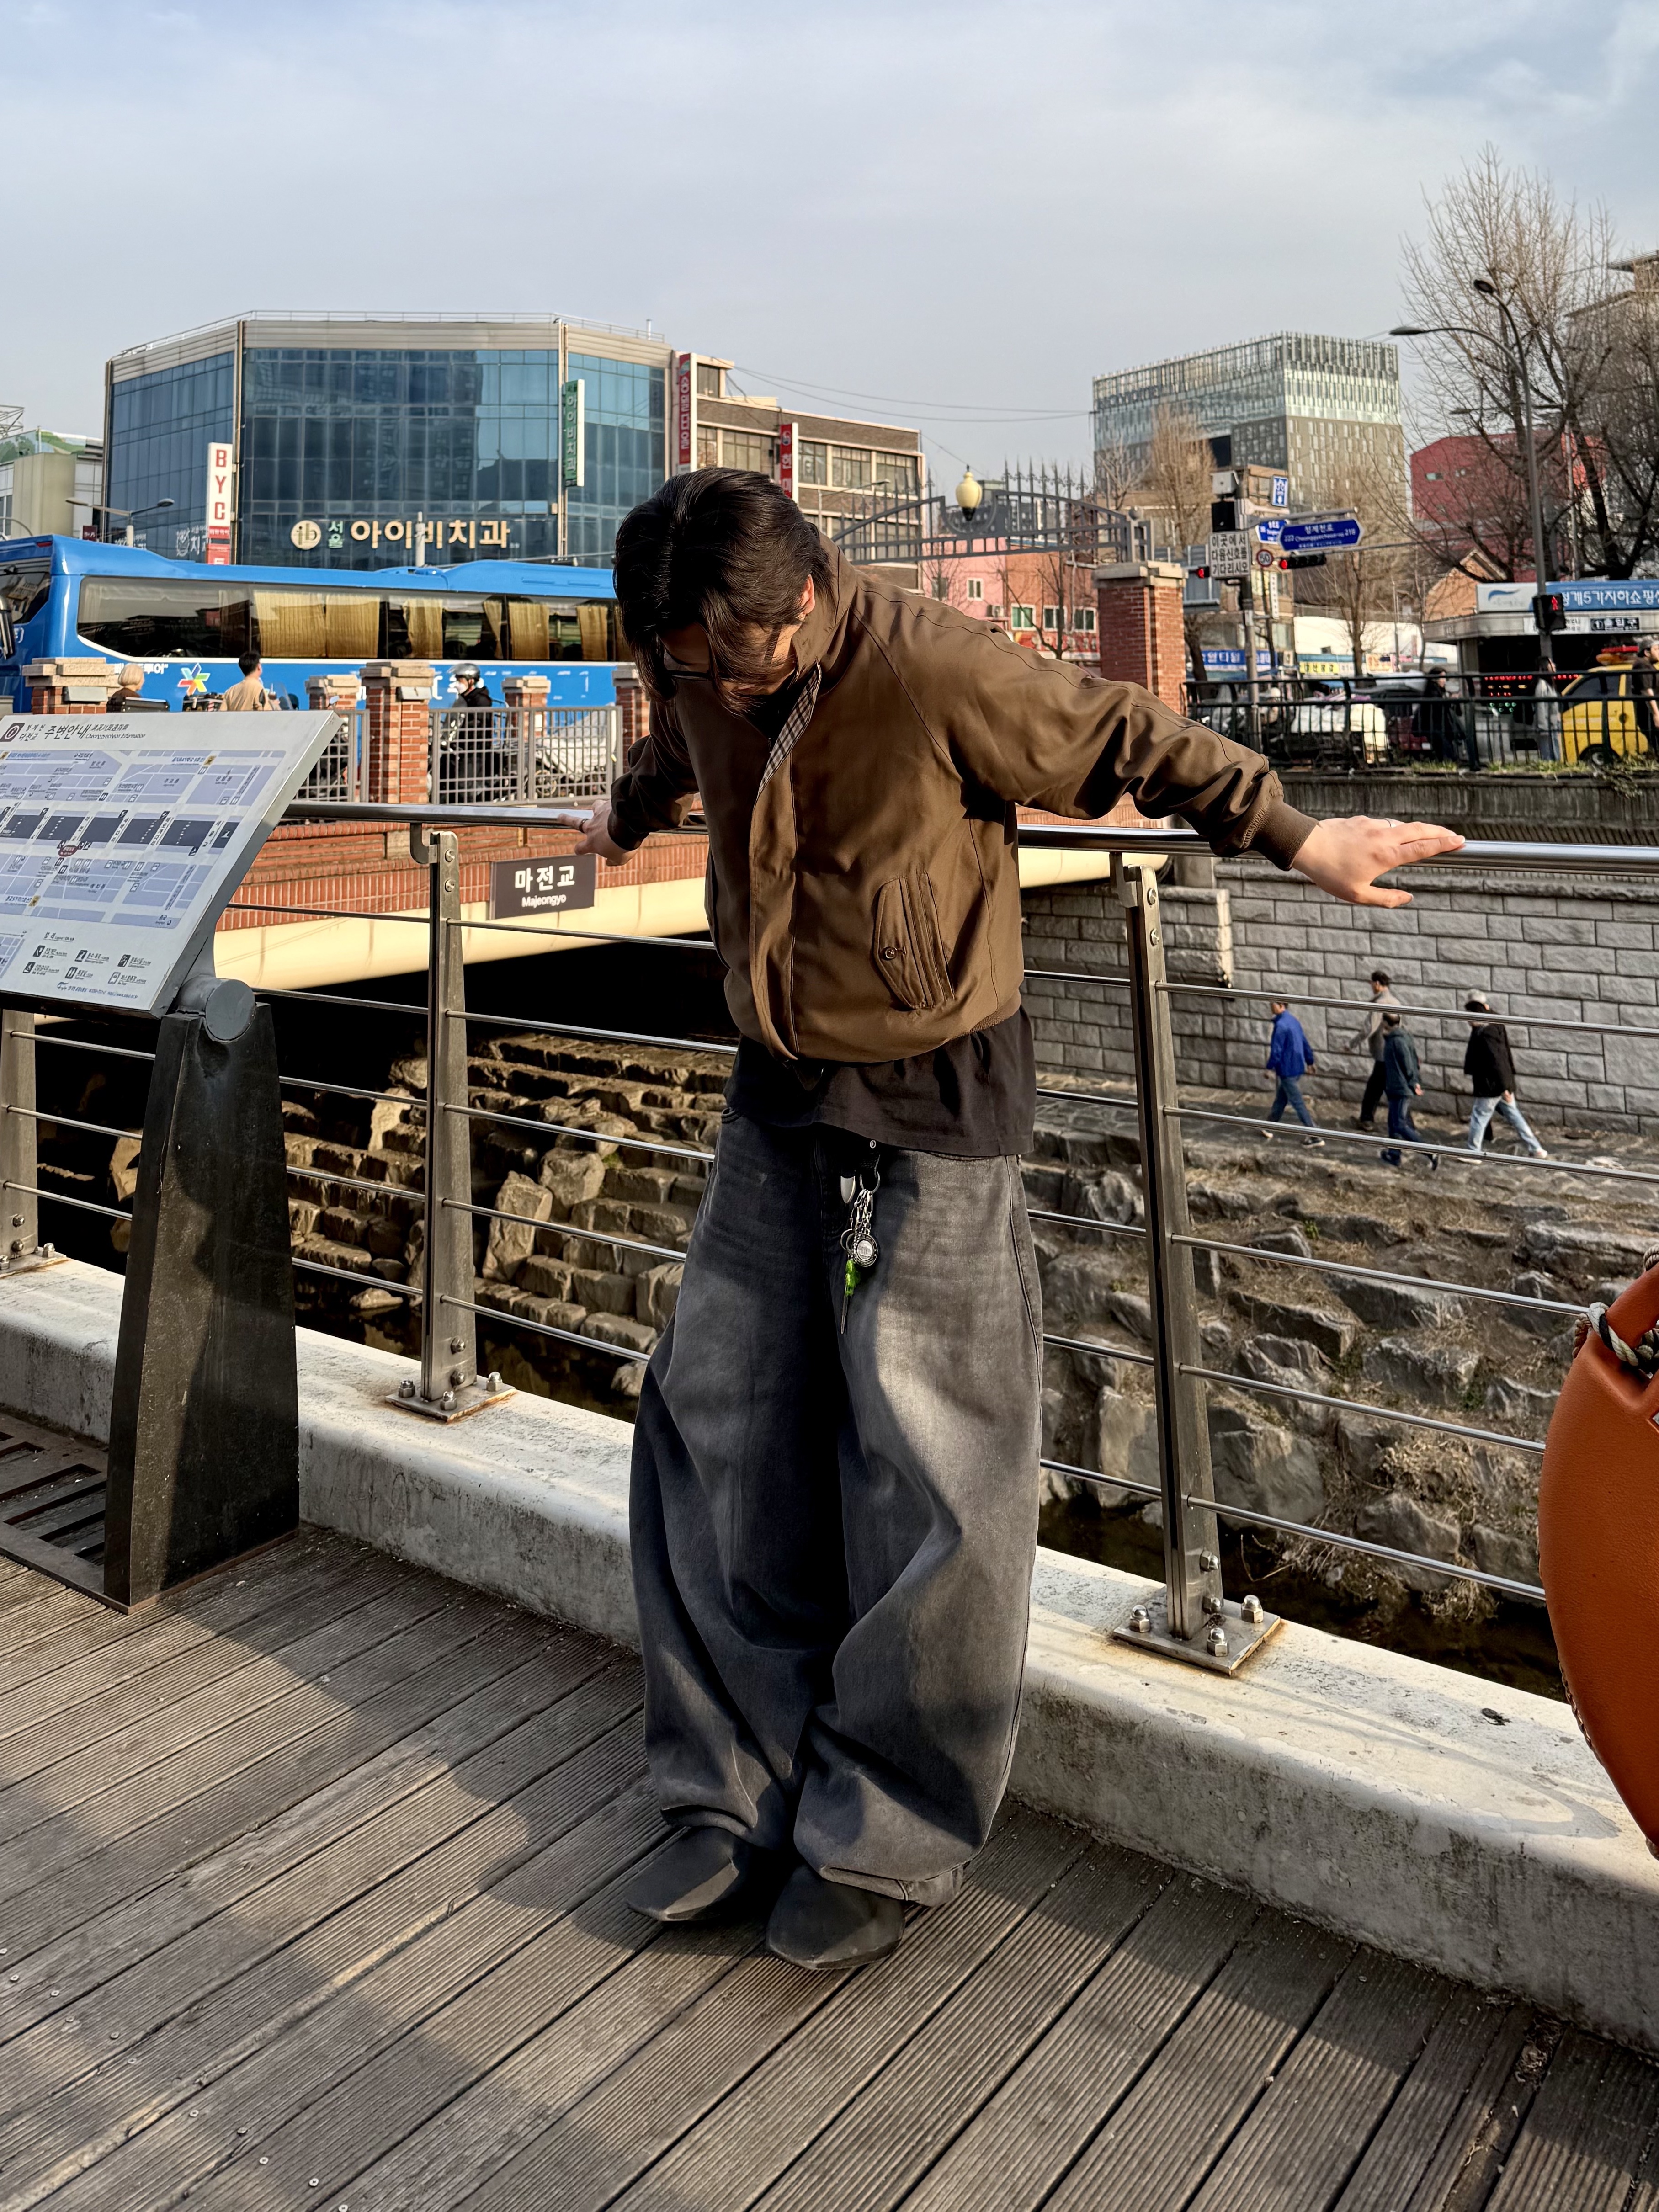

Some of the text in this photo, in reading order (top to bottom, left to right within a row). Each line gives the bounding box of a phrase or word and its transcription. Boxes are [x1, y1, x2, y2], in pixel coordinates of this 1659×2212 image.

[567, 395, 577, 471] 아이비치과
[214, 449, 228, 520] BYC
[328, 520, 510, 549] 서울 아이비치과
[1212, 561, 1248, 574] 기다리시오
[44, 724, 91, 739] 주변안내
[515, 865, 575, 893] 마전교
[521, 894, 567, 908] Majeongyo
